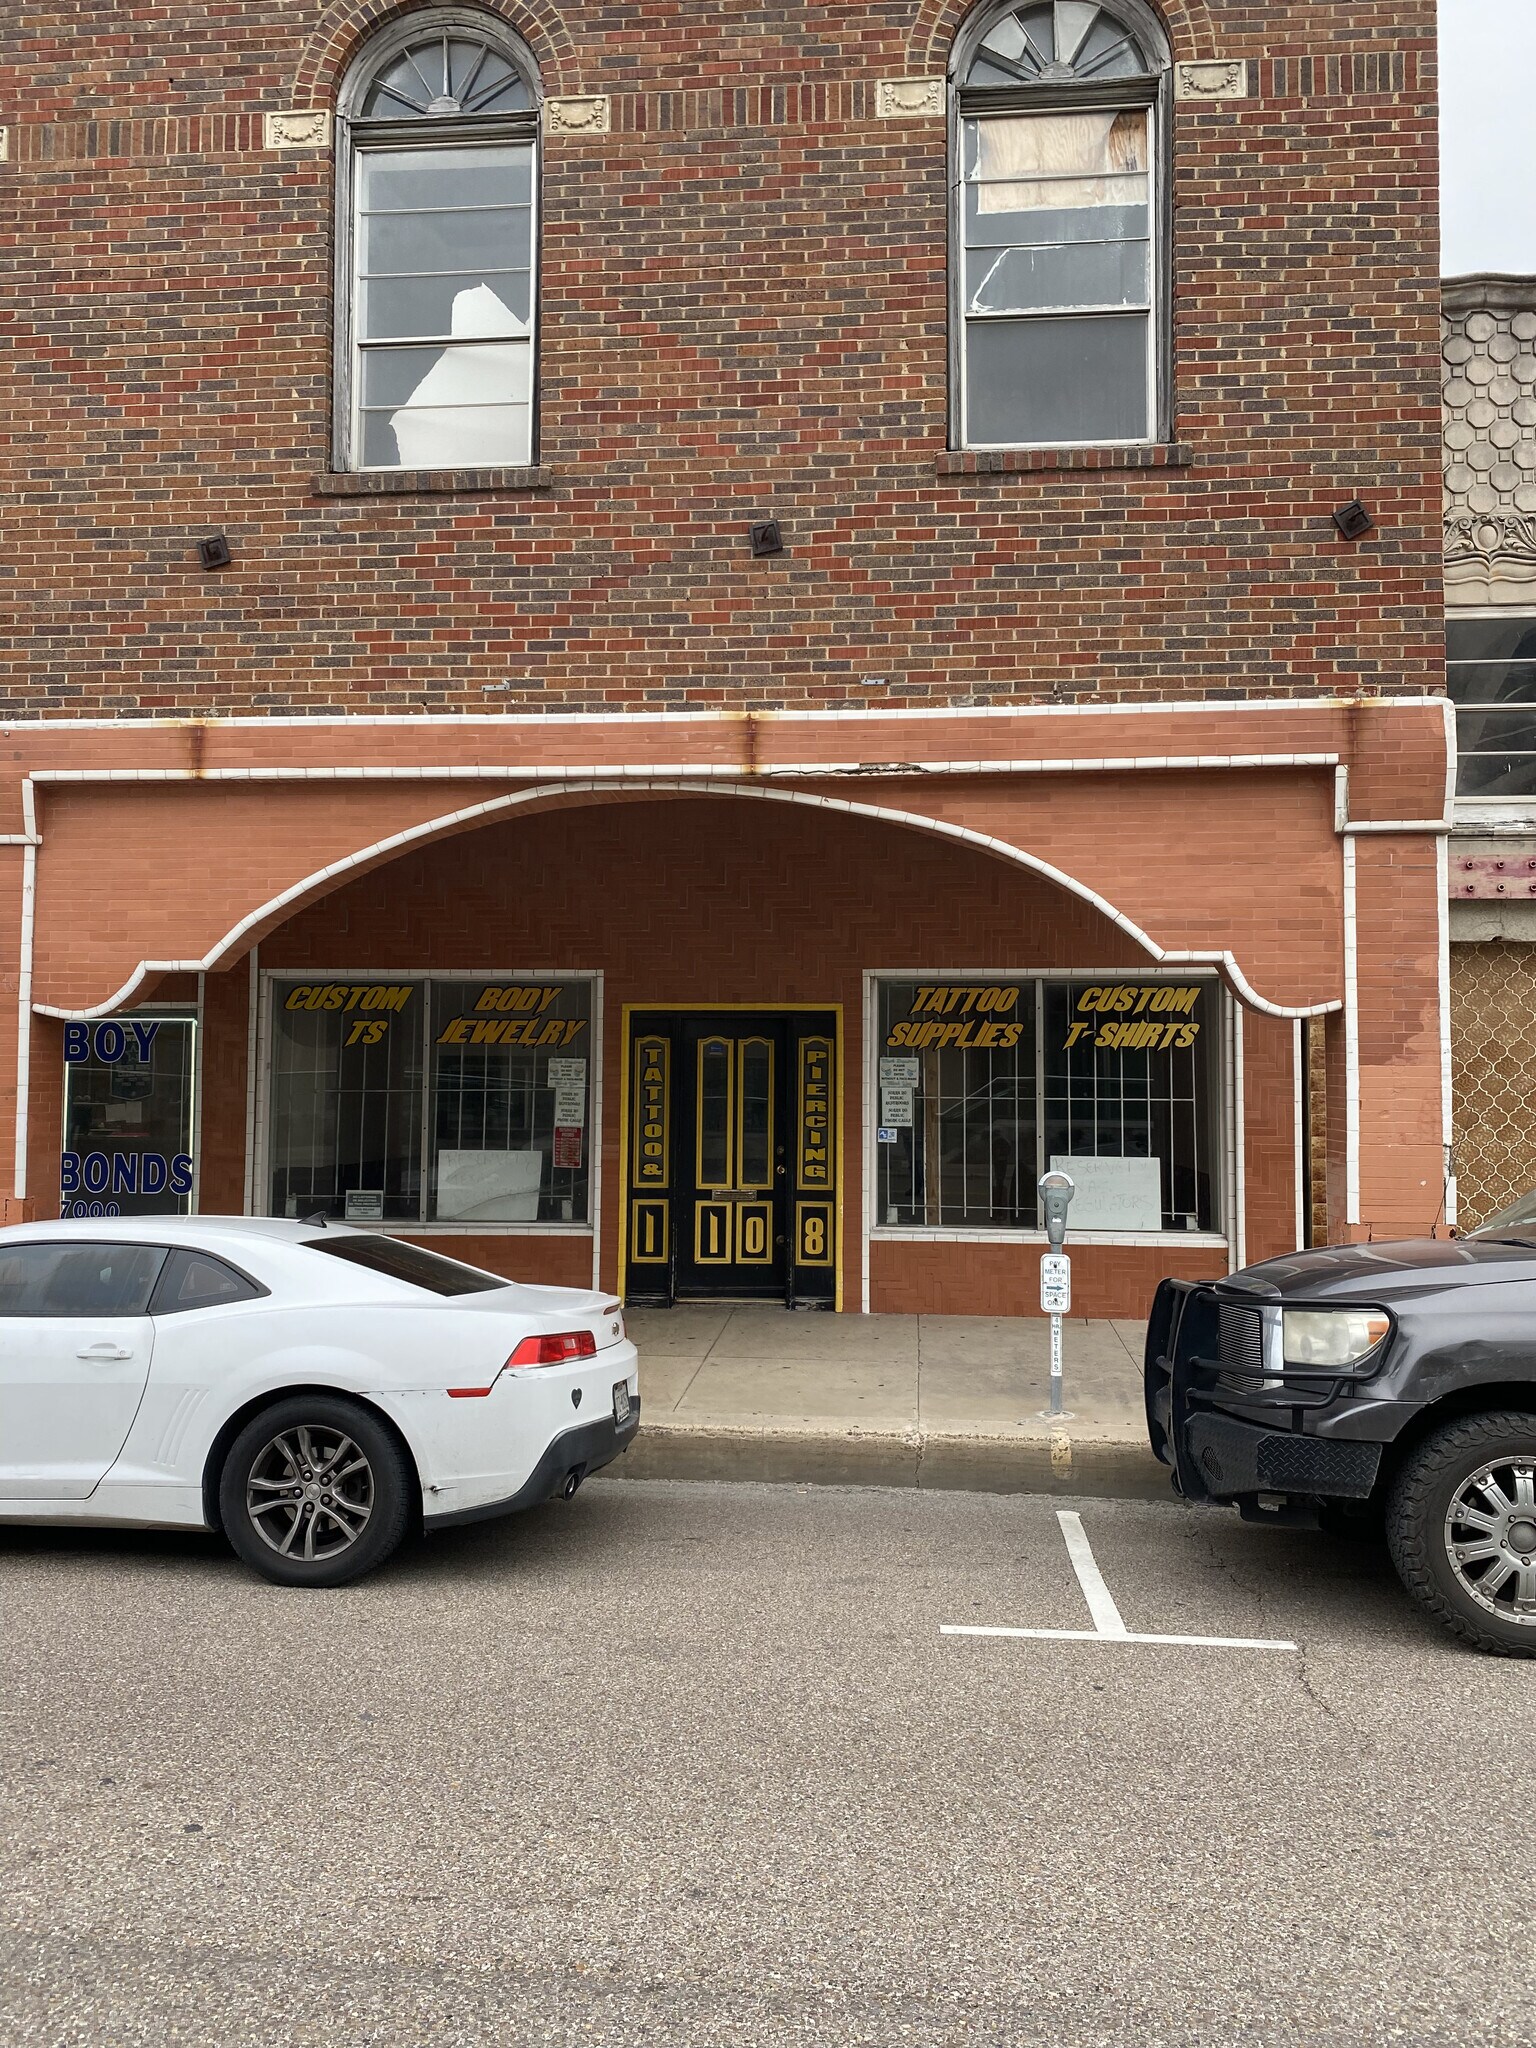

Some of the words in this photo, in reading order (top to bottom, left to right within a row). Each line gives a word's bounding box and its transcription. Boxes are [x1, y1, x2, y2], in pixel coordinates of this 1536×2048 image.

[284, 982, 415, 1013] CUSTOM
[472, 986, 564, 1015] BODY
[907, 986, 1020, 1016] TATTOO
[1076, 983, 1202, 1016] CUSTOM
[64, 1021, 161, 1063] BOY
[343, 1020, 390, 1049] TS
[434, 1014, 588, 1049] JEWELRY
[886, 1018, 1024, 1052] SUPPLIES
[804, 1051, 827, 1179] PIERCING
[61, 1151, 193, 1195] BONDS
[60, 1200, 120, 1218] 7000
[1044, 1291, 1067, 1299] SPACE
